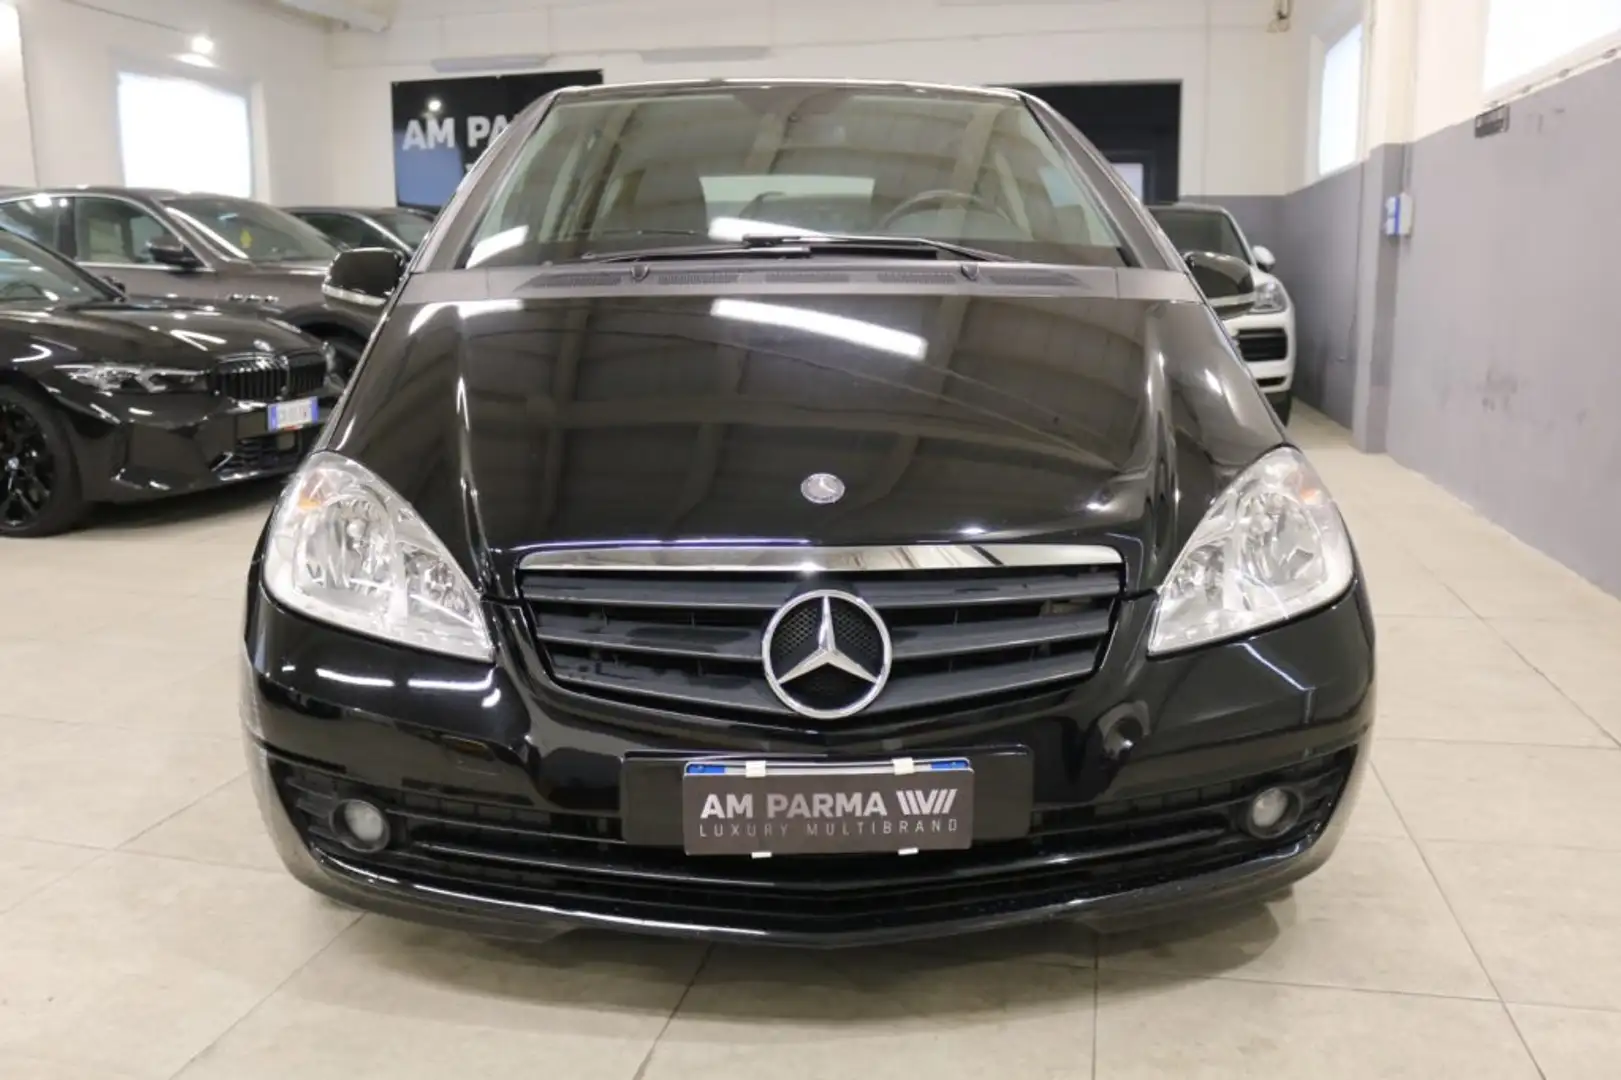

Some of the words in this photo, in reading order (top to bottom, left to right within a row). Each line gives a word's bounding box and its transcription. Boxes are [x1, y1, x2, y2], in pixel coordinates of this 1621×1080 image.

[402, 118, 456, 150] AM
[700, 793, 754, 819] AM
[766, 791, 887, 818] PARMA
[699, 822, 788, 838] LUXURY
[806, 818, 957, 837] MULTIBRAND
